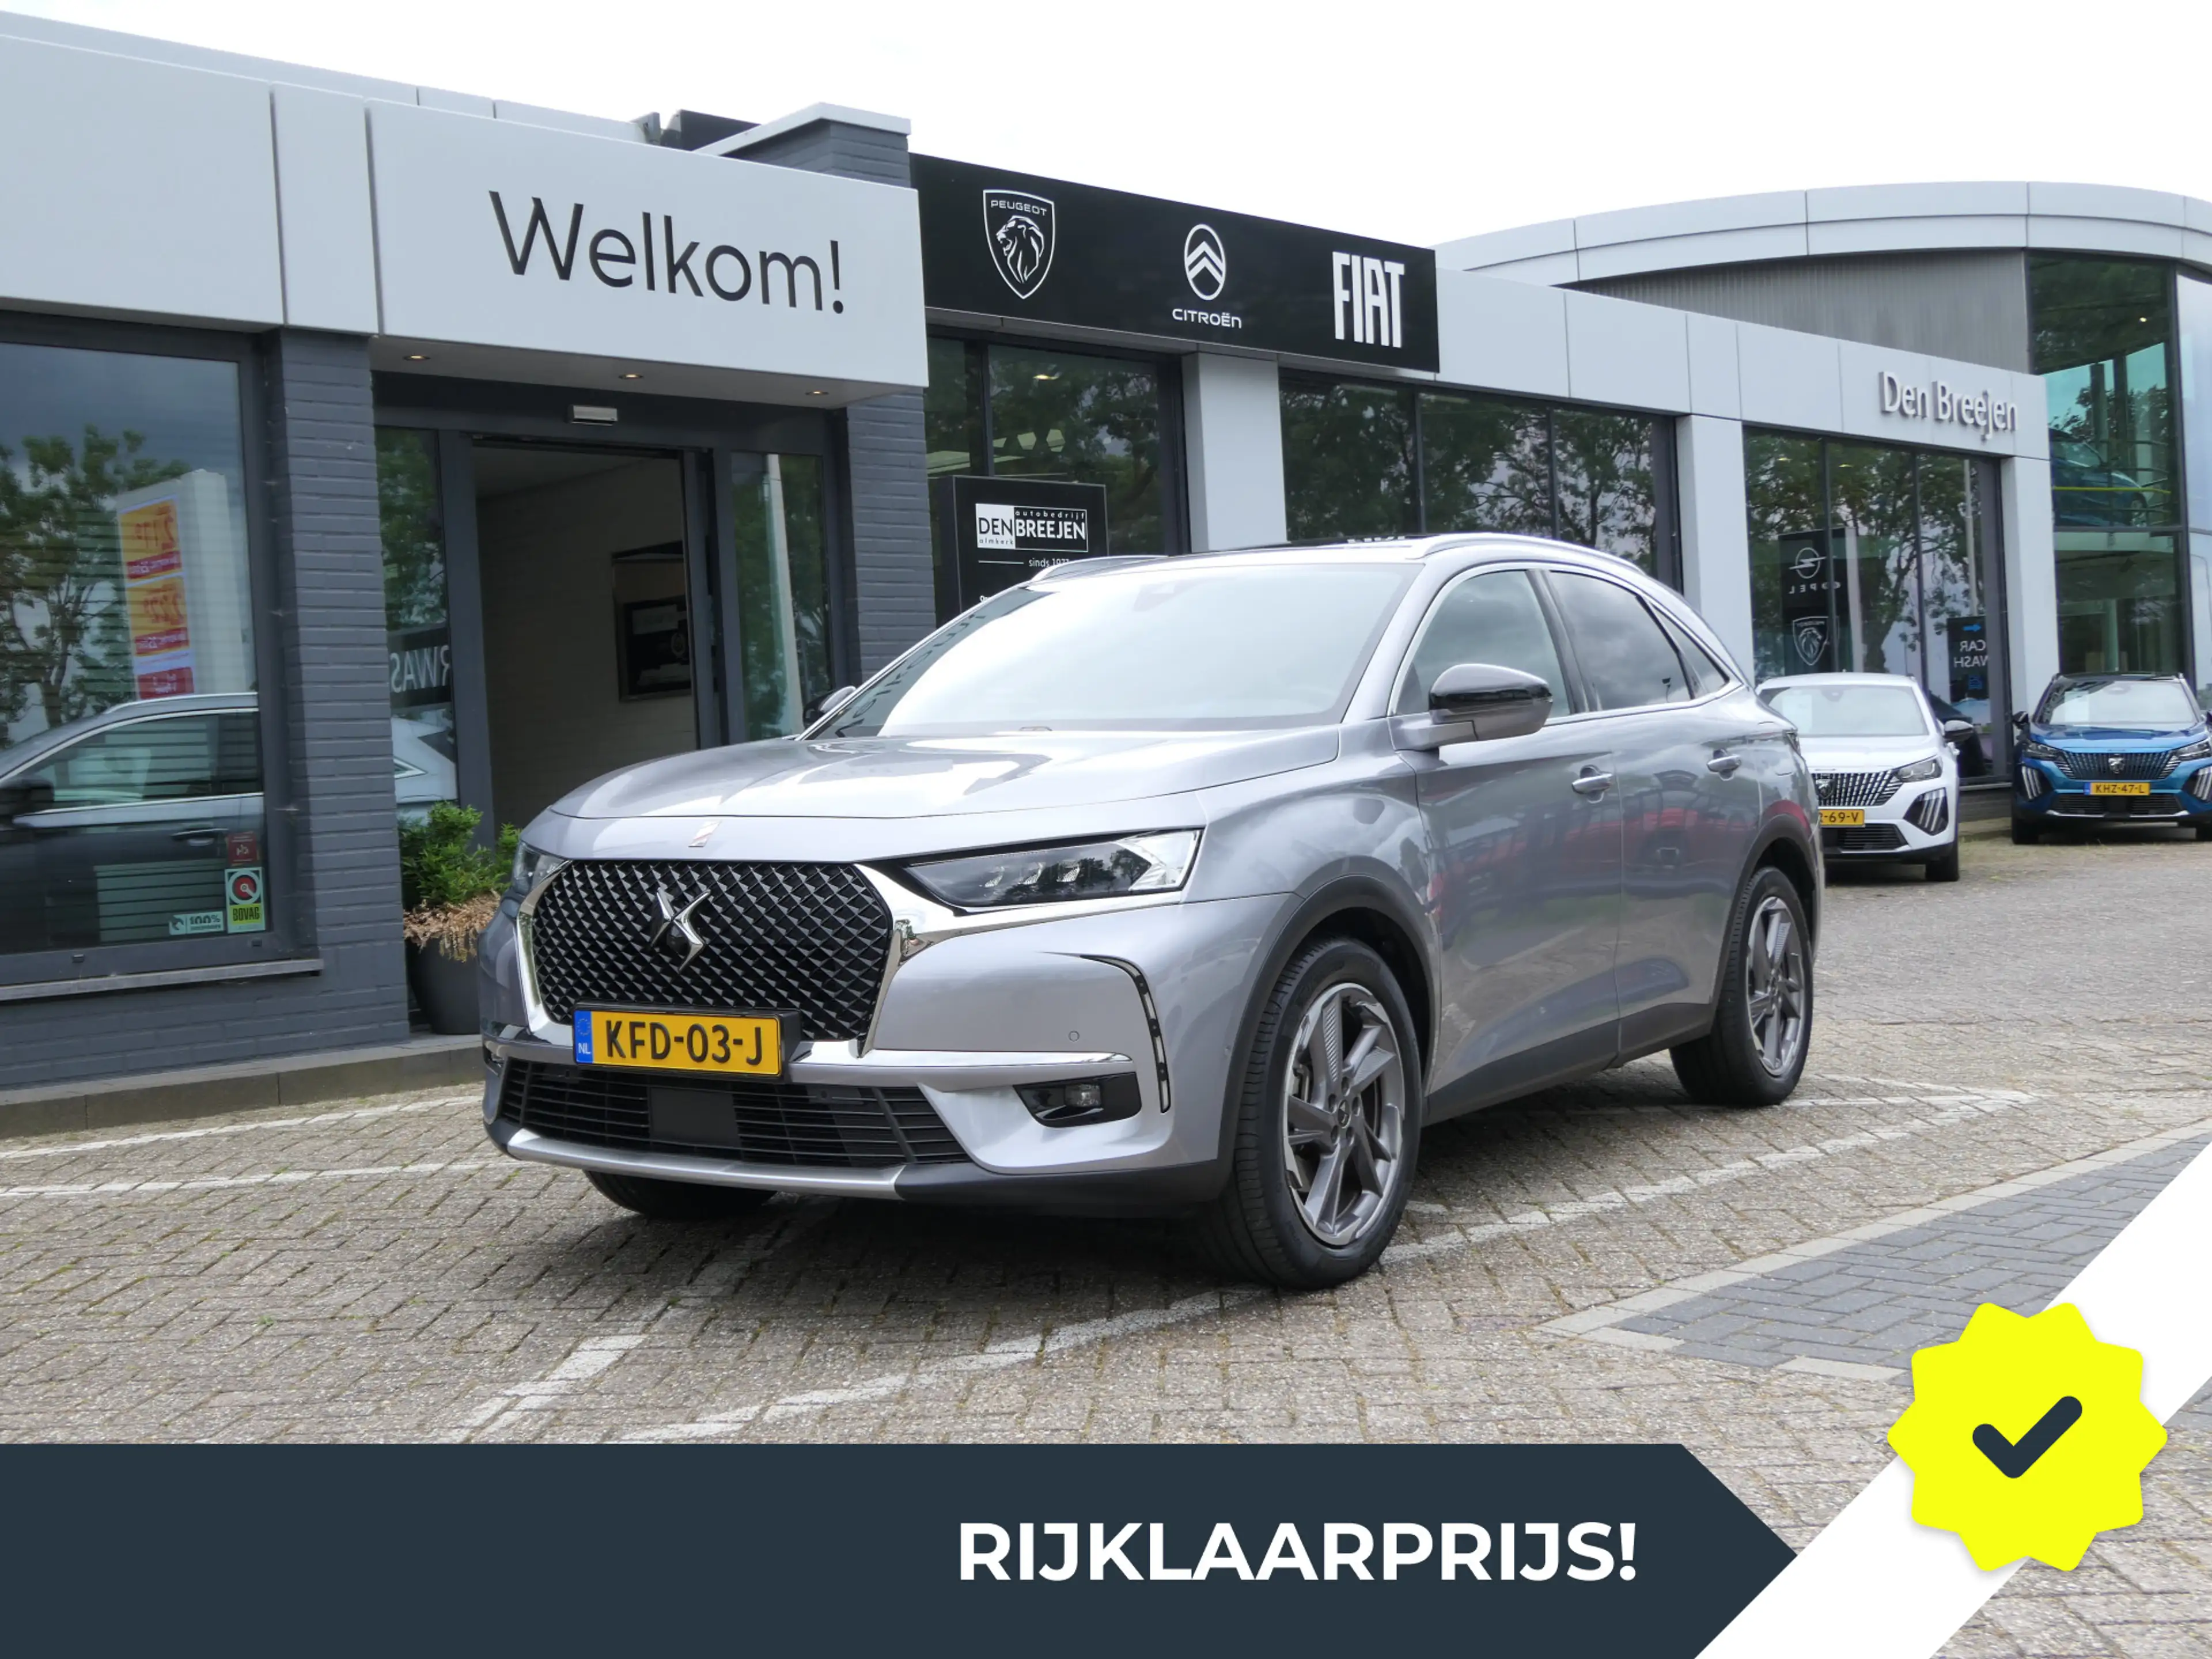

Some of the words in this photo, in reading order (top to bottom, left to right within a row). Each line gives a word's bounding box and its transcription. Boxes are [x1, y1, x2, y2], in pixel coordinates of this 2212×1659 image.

[990, 199, 1047, 217] PEUGEOT
[488, 190, 843, 315] Welkom!
[1332, 251, 1405, 349] FIAT
[1878, 372, 1930, 419] Den
[1931, 381, 2019, 441] Breejen
[1015, 510, 1085, 520] autobedrijf
[979, 517, 1013, 536] DEN
[1016, 519, 1086, 540] BREEJEN
[1029, 558, 1050, 567] sinds
[2095, 784, 2145, 794] KHZ-47-L
[190, 914, 221, 925] 100%
[233, 907, 260, 922] BOVAG
[578, 1042, 591, 1055] NL
[605, 1020, 763, 1066] KFD-03-J
